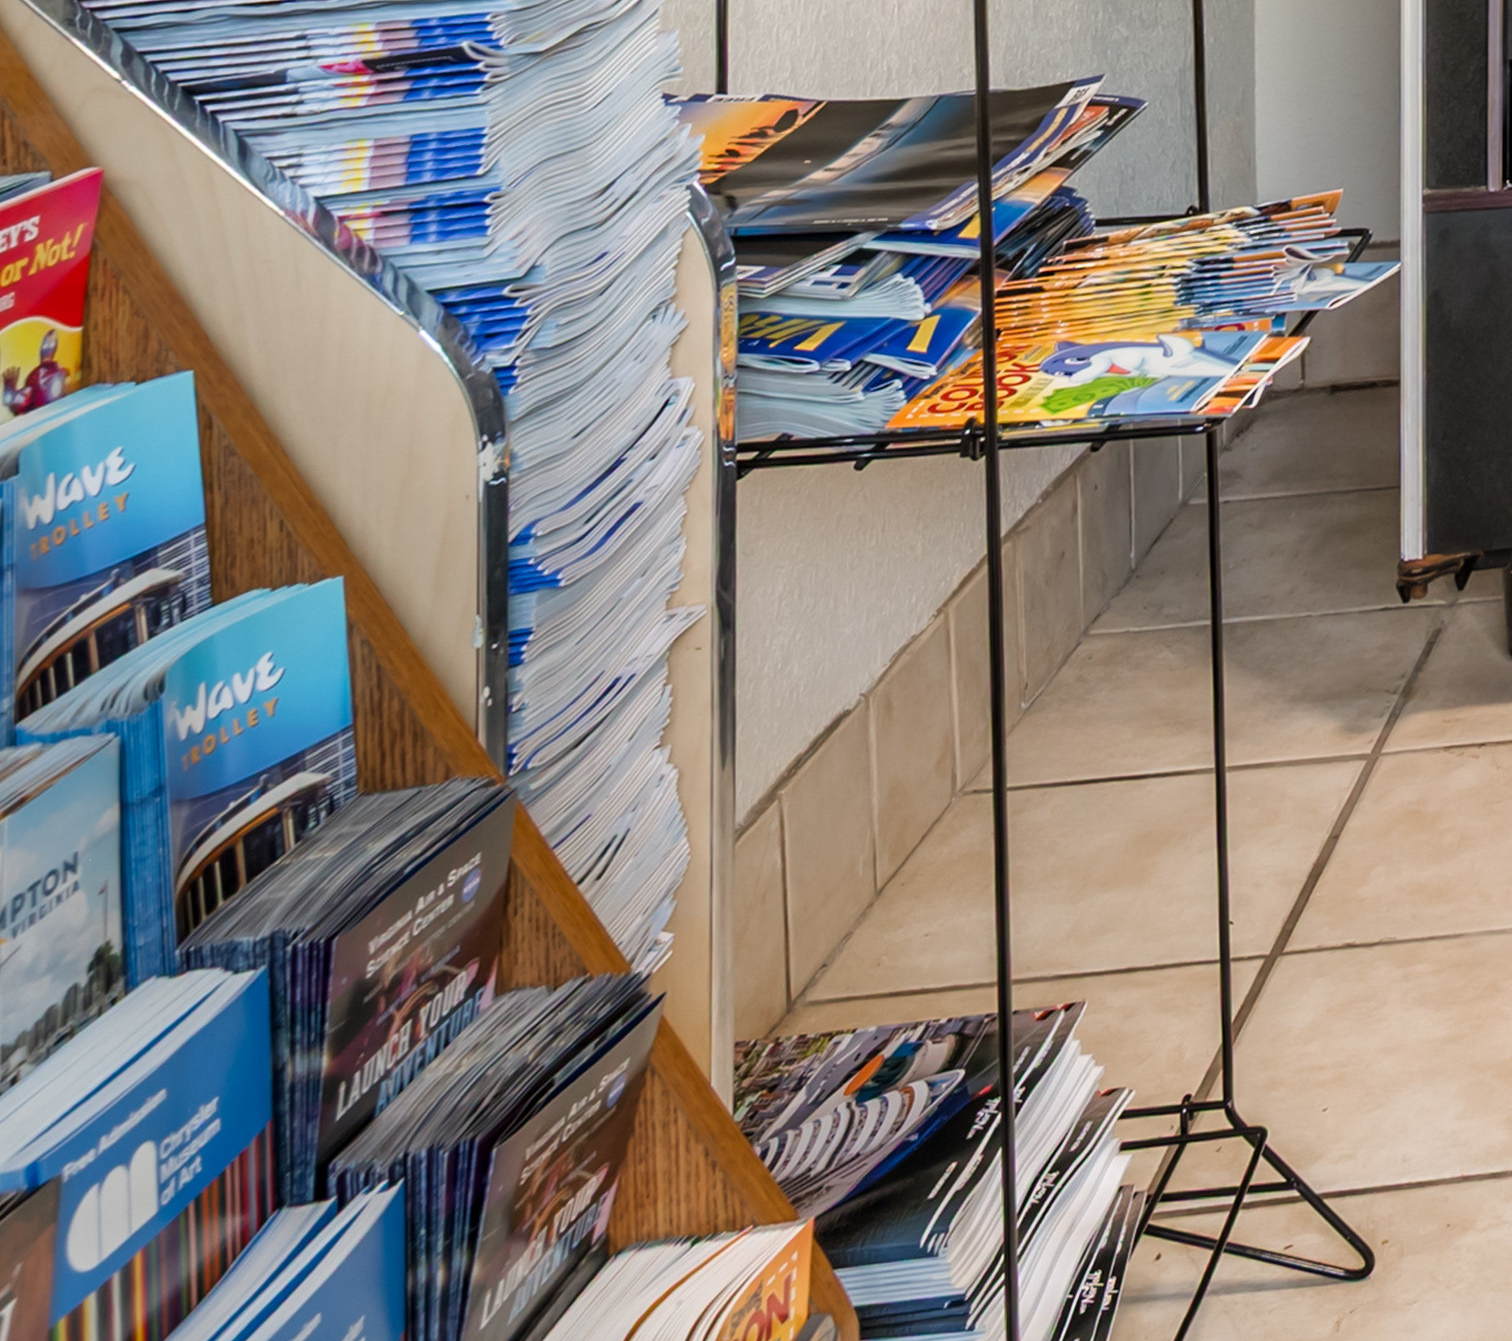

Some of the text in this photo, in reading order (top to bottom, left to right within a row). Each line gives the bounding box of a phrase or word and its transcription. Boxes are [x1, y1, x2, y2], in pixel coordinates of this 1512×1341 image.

[1, 221, 86, 288] or Not!
[29, 492, 130, 561] TROLLEY
[181, 697, 280, 773] TROLLEY
[0, 850, 79, 931] PTON
[11, 879, 79, 940] VIRGINIA
[335, 969, 468, 1122] LAUNCH YOUR
[374, 984, 487, 1119] ADVENTURE
[62, 1088, 168, 1184] Free Admission
[160, 1095, 220, 1160] Chrysler
[160, 1117, 222, 1185] Museum
[160, 1156, 203, 1207] of Art
